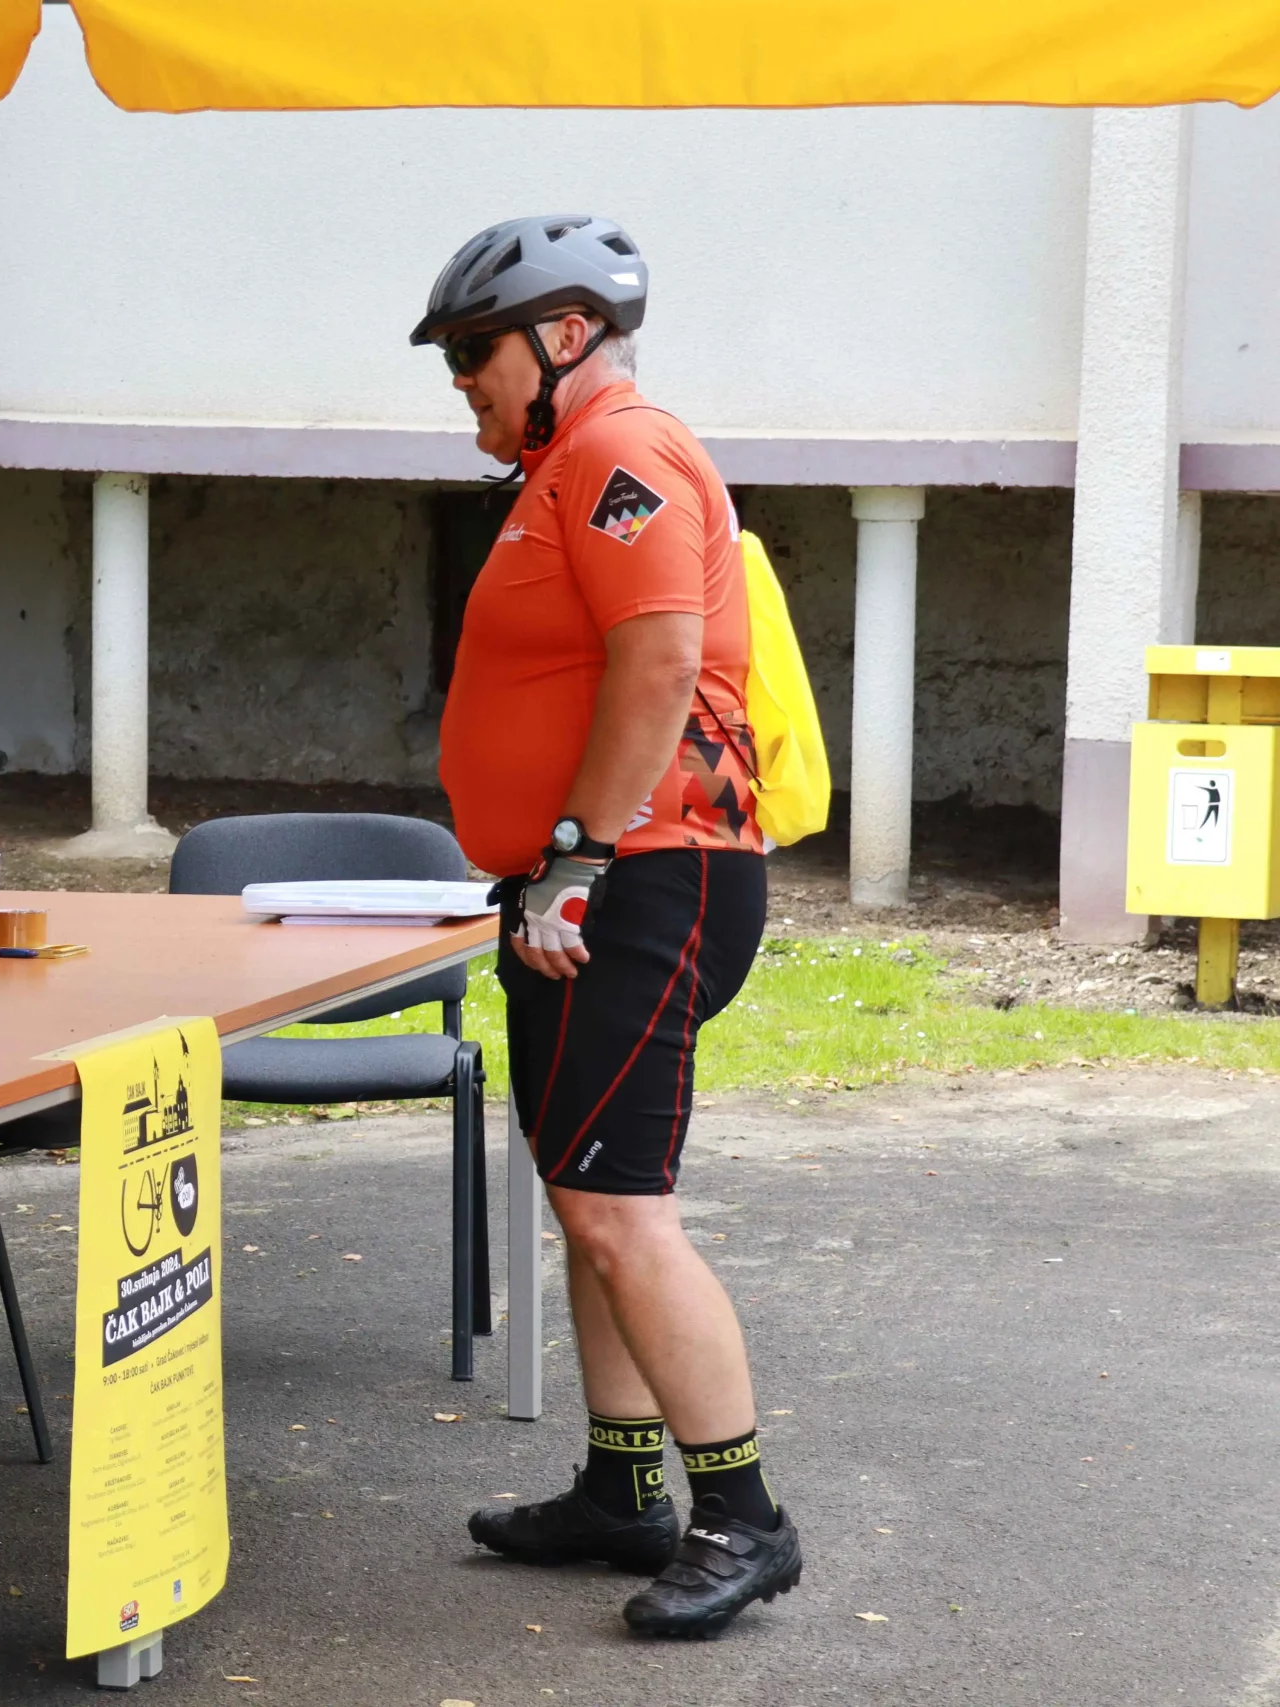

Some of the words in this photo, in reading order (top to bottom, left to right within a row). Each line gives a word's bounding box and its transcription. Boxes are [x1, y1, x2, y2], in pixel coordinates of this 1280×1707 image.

[578, 1140, 603, 1172] cycling
[105, 1307, 140, 1344] ČAK
[140, 1284, 174, 1326] BAJK
[174, 1278, 185, 1302] &
[185, 1257, 210, 1296] POLI
[683, 1437, 759, 1468] SPOR
